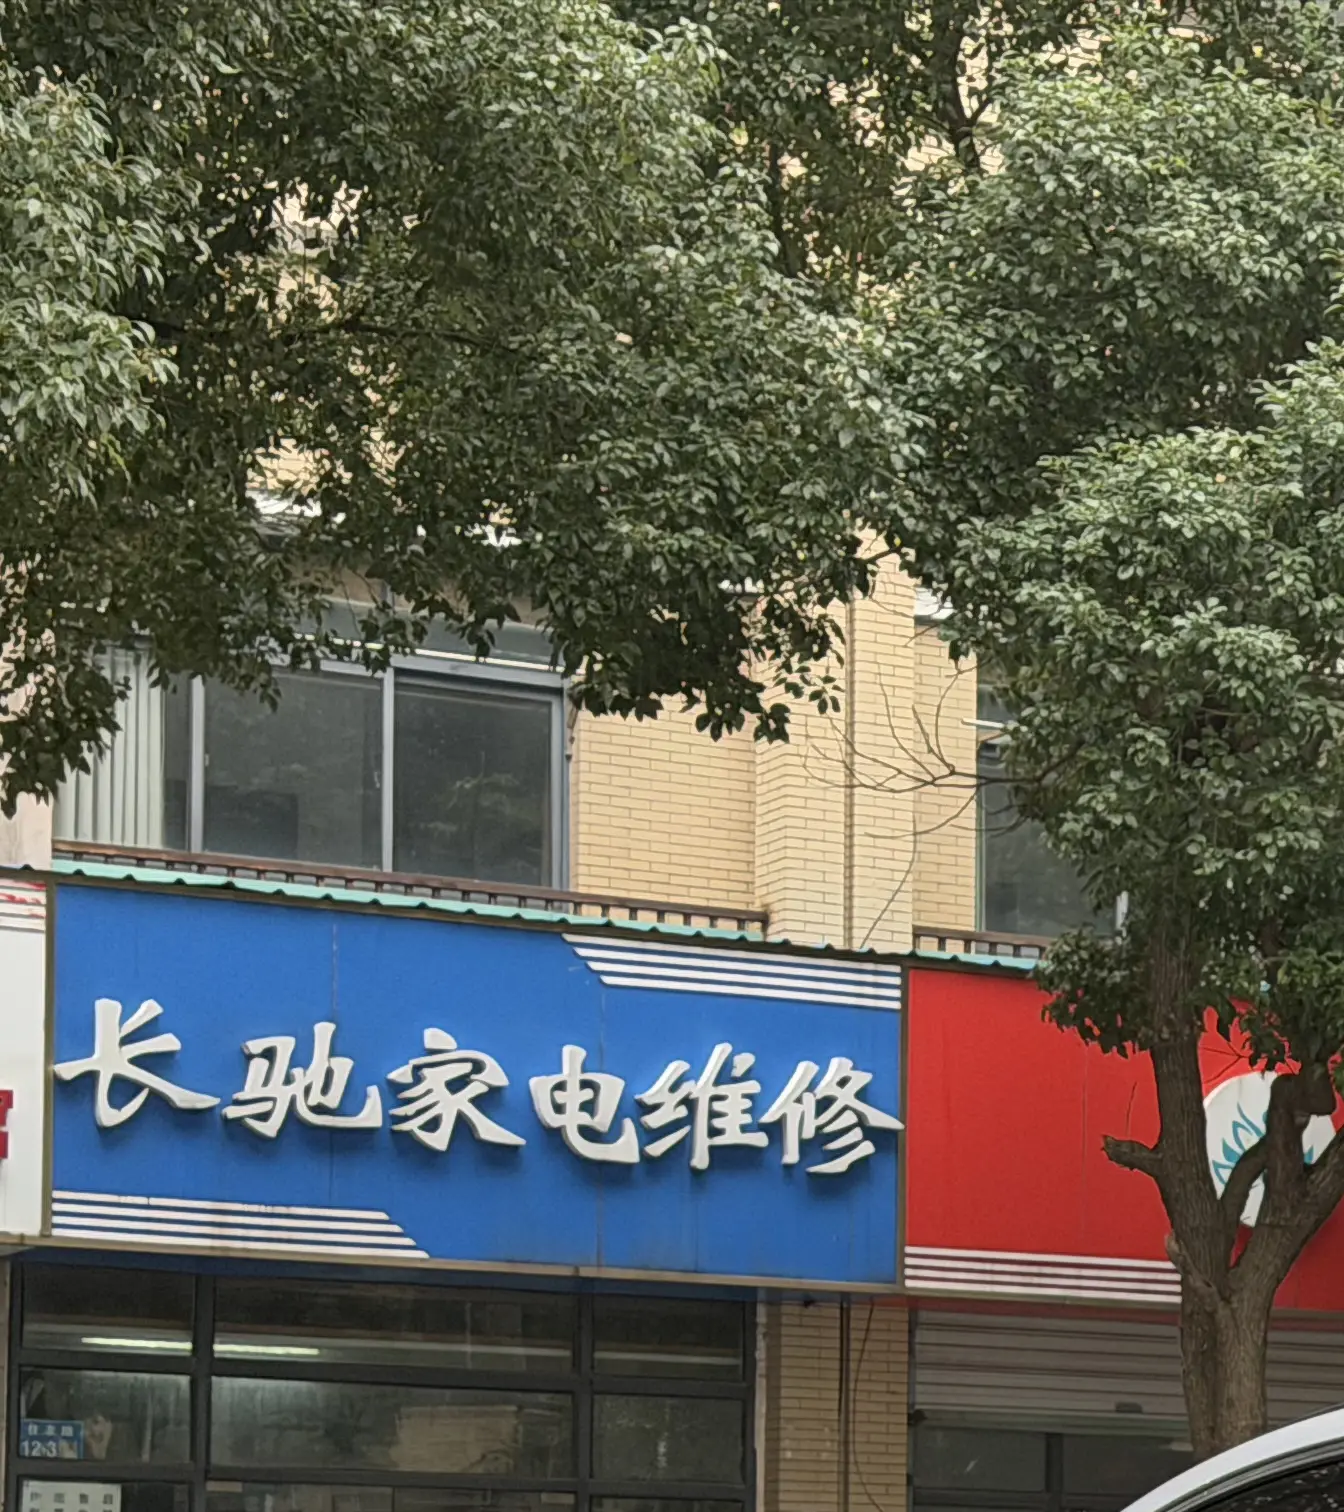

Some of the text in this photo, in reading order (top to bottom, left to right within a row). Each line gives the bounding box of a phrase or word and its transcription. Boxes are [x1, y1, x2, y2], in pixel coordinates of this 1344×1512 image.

[55, 998, 904, 1174] 长驰家电维修
